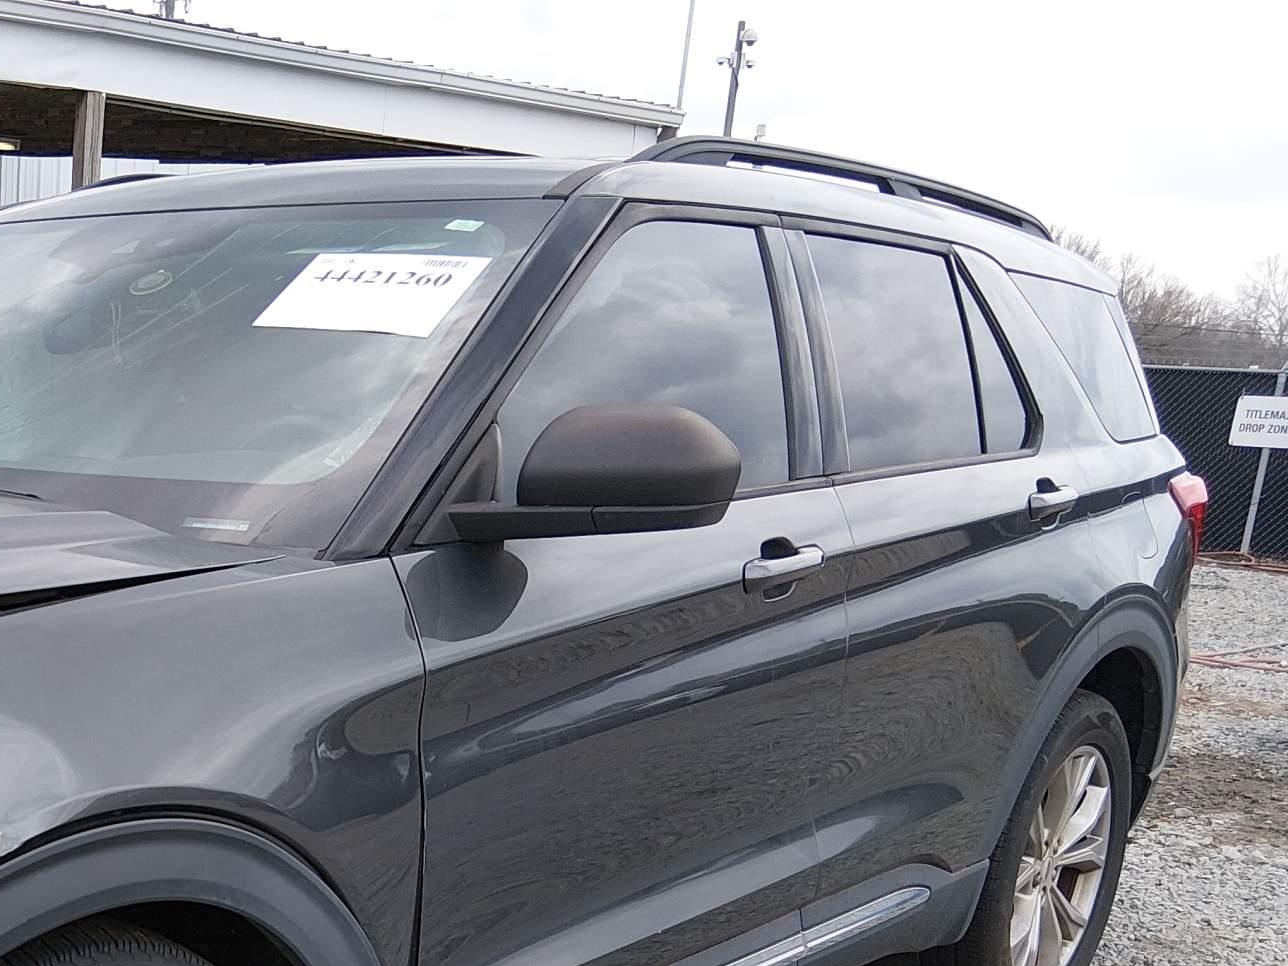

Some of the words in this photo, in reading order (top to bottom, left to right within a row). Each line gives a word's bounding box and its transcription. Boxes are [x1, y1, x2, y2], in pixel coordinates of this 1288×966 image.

[315, 269, 452, 287] 44421260
[1245, 409, 1288, 420] TITLEMA
[1239, 423, 1265, 433] DROP
[1267, 425, 1288, 434] ZON
